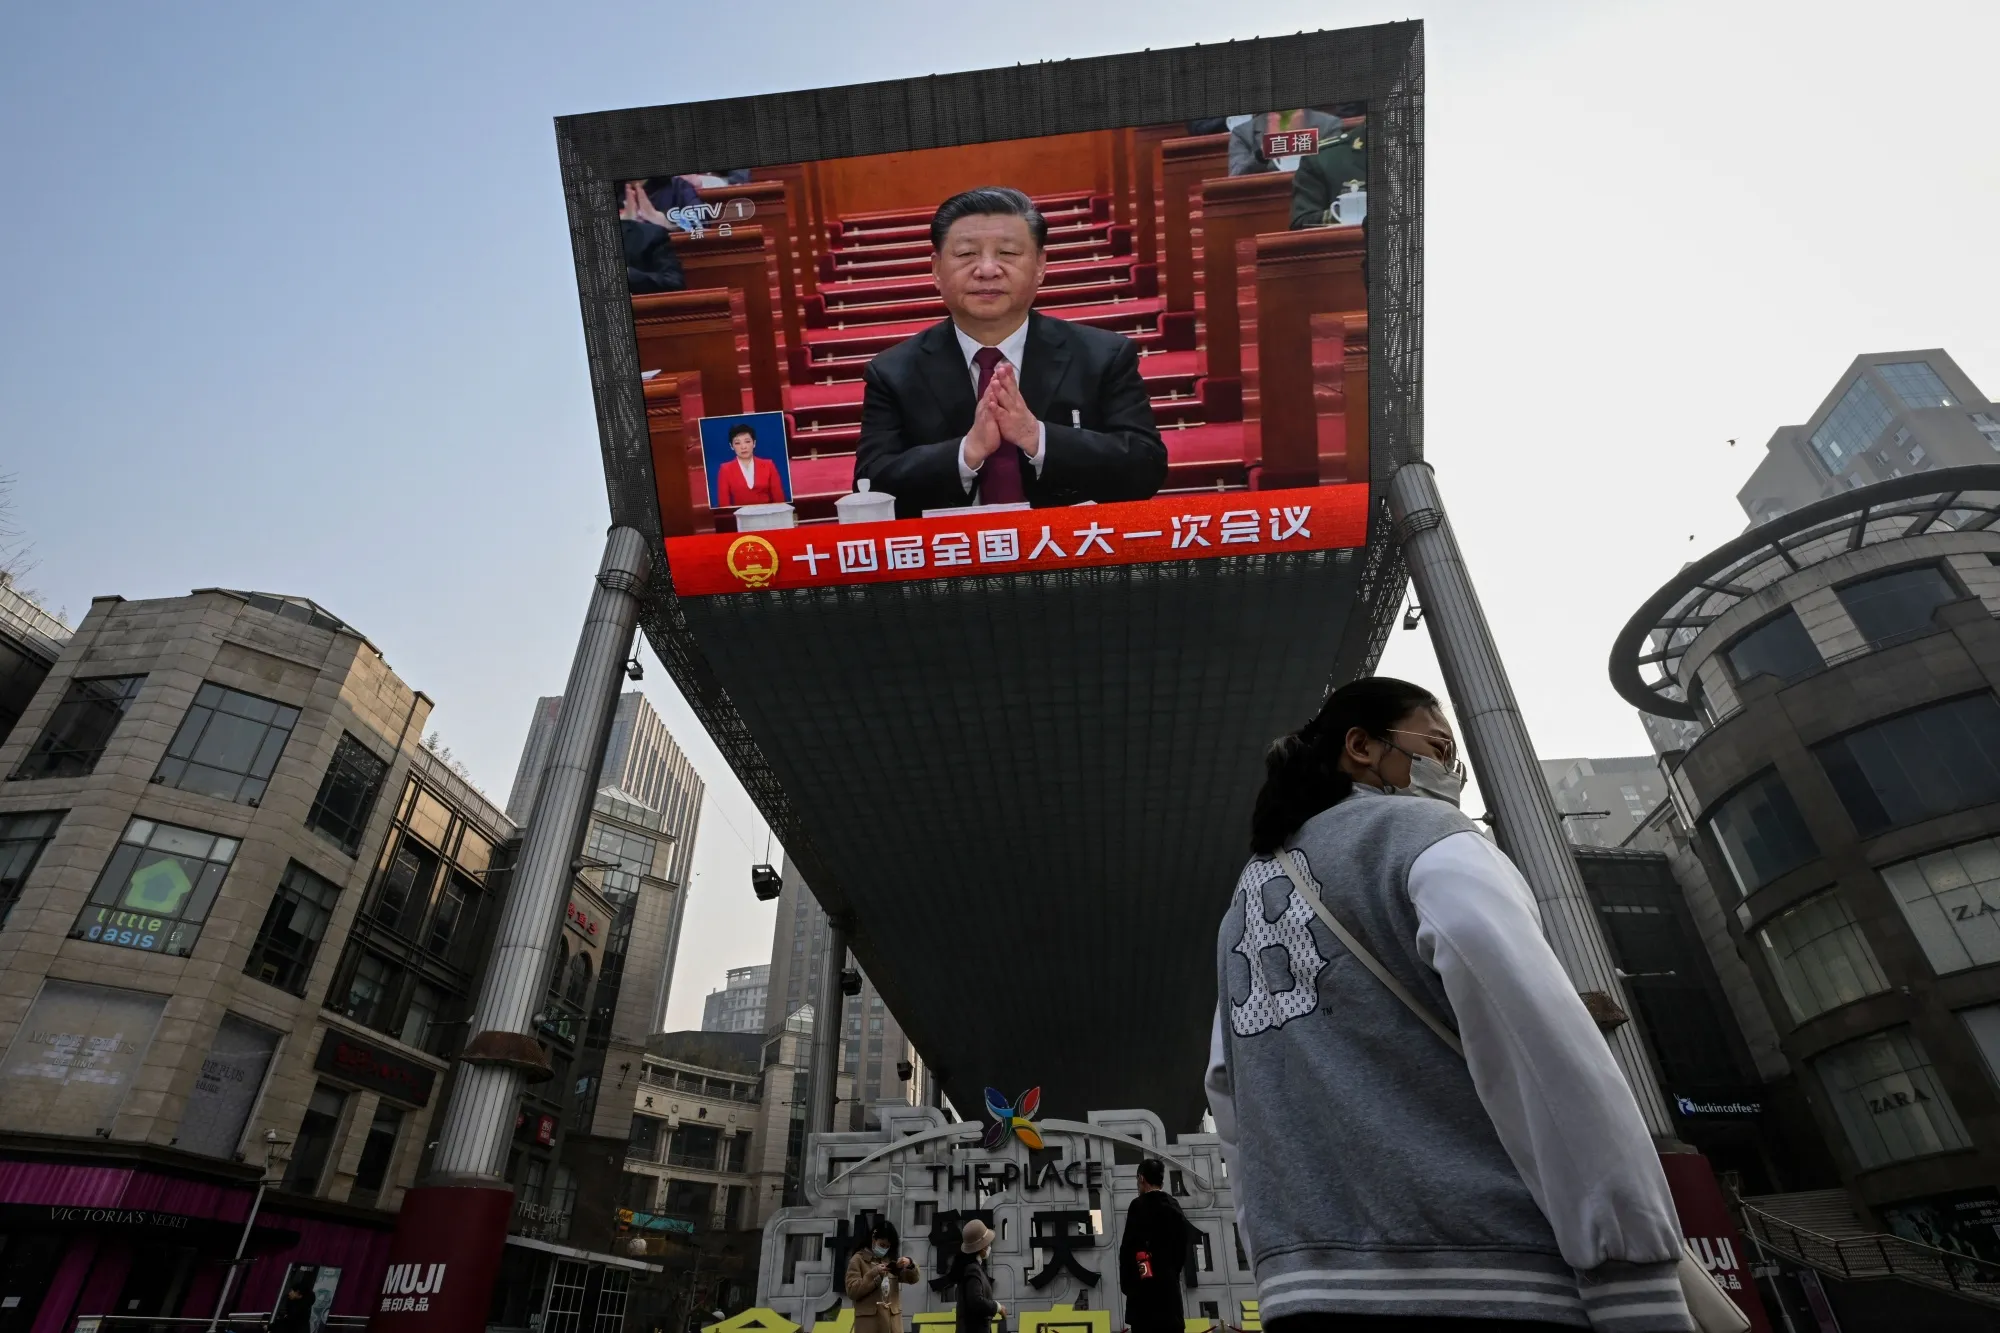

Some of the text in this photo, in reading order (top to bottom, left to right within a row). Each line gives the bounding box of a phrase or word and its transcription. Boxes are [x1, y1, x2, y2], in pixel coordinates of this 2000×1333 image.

[1269, 133, 1312, 154] 直播
[667, 202, 744, 222] CCTV 1
[690, 223, 732, 239] 综合
[793, 506, 1312, 577] 十四届全国人大一次会议
[88, 925, 155, 948] oasis
[1231, 848, 1329, 1038] B
[1321, 1007, 1333, 1017] TM
[1869, 1087, 1931, 1114] ZARA
[924, 1160, 1103, 1192] THE PLACE
[51, 1207, 188, 1229] VICTORIA'S SECRET
[518, 1200, 538, 1220] THE
[1684, 1237, 1740, 1271] UJI
[381, 1263, 447, 1295] MUJI
[380, 1296, 430, 1312] 無印良品
